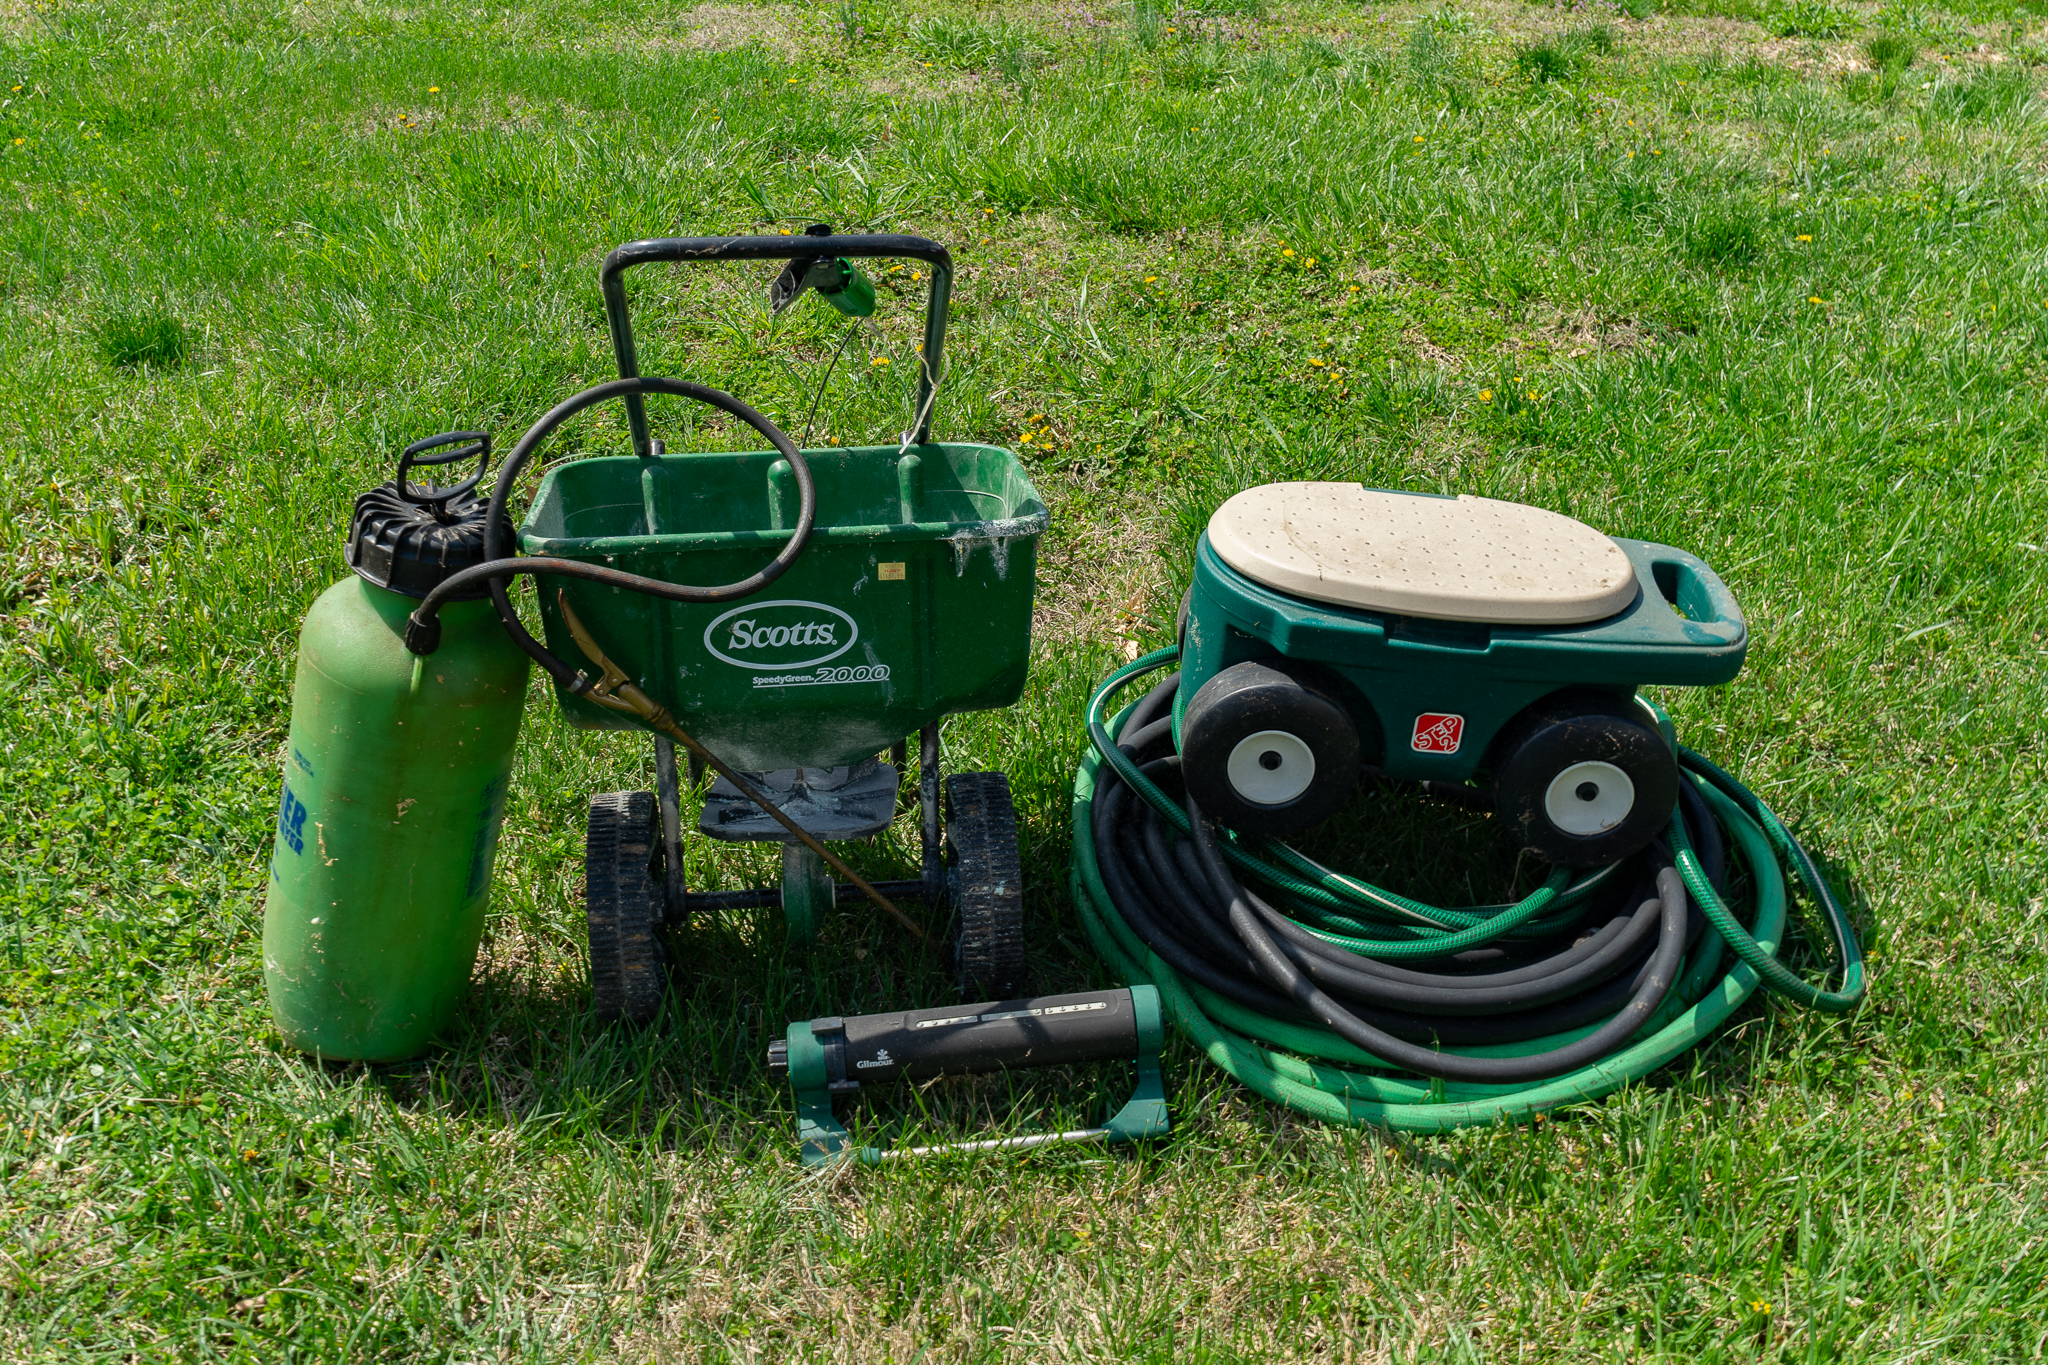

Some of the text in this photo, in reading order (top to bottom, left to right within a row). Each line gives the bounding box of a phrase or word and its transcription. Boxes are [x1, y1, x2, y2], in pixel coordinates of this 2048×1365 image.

[728, 619, 836, 649] Scotts
[753, 664, 890, 686] SpeedyGreen 2000
[1415, 716, 1458, 749] STEP
[1439, 735, 1458, 752] 2
[856, 1059, 894, 1069] Gilmour
